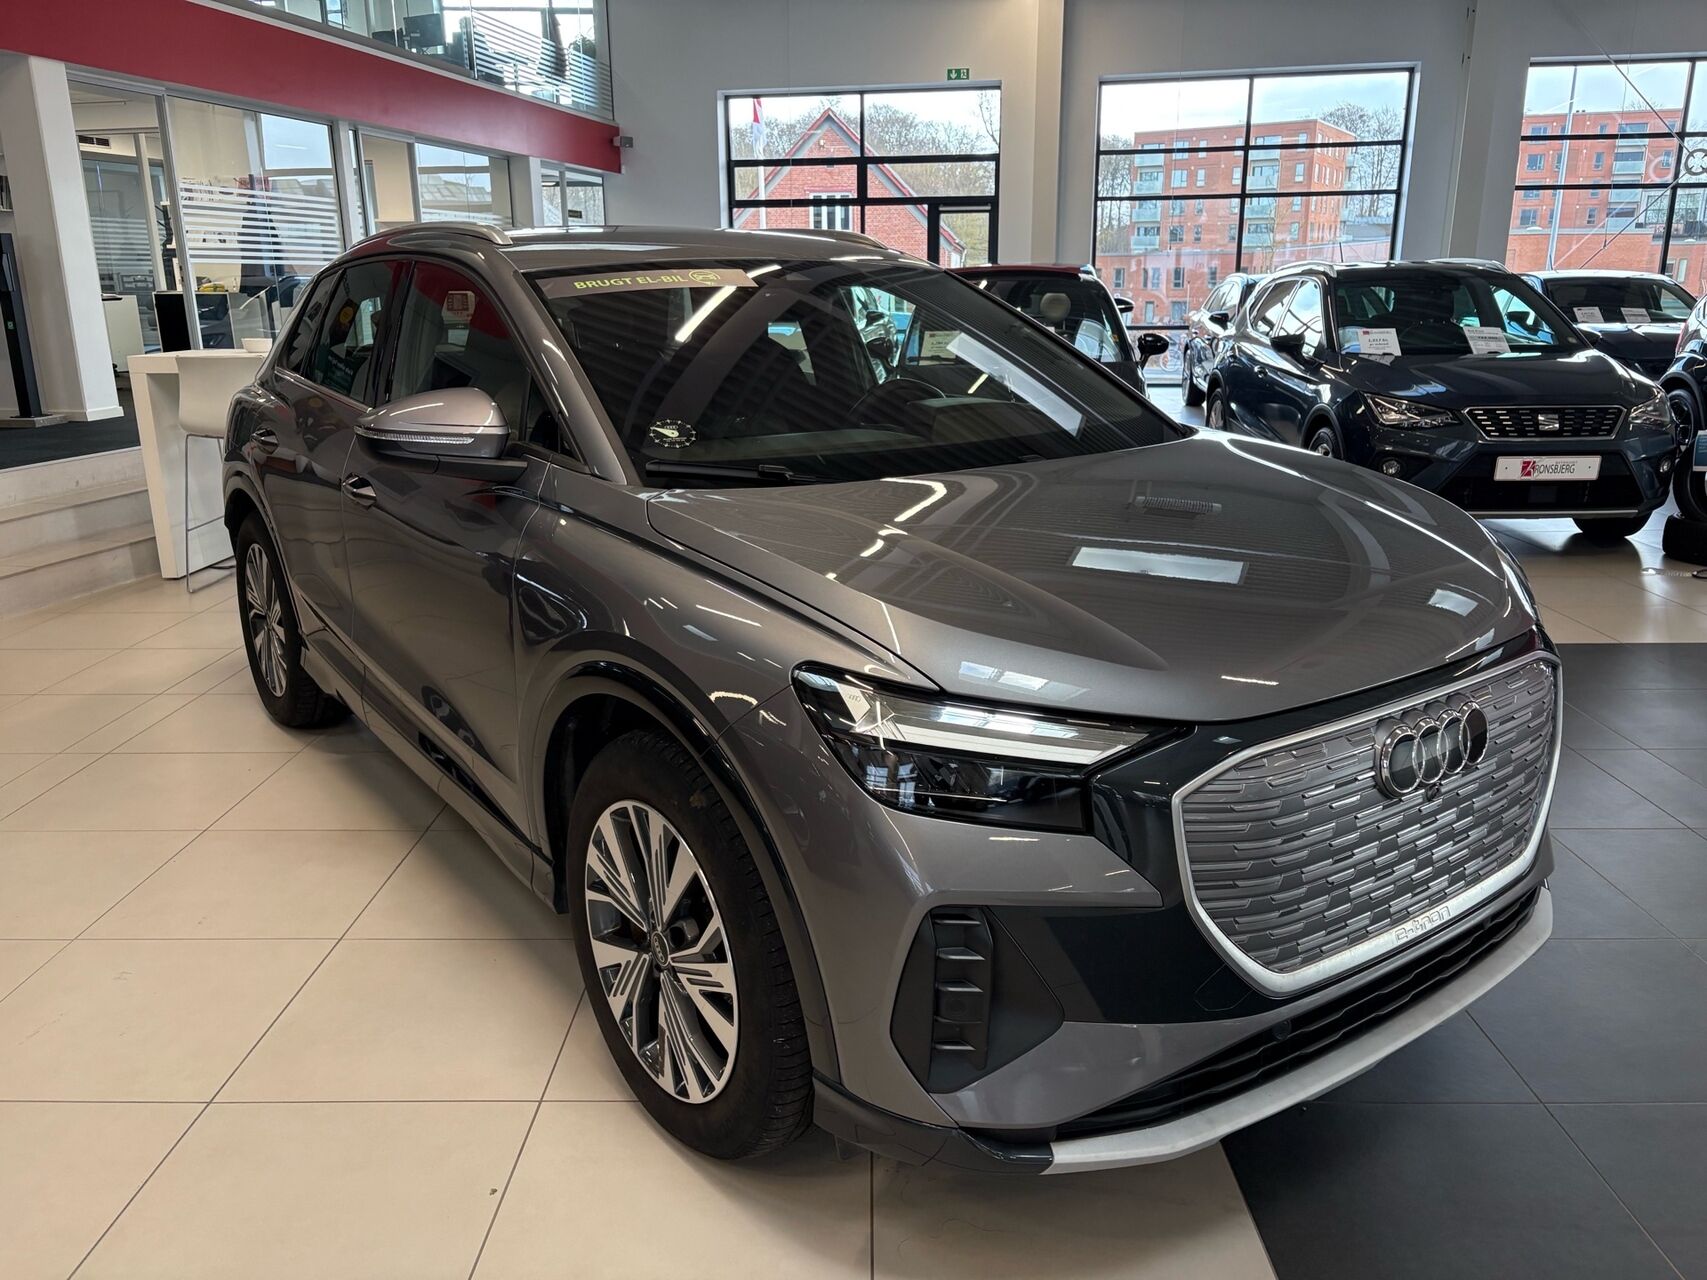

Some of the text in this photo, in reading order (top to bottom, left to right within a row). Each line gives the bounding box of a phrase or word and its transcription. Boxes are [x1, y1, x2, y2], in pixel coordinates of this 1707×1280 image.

[573, 274, 688, 290] BRUGT EL-BIL
[1394, 905, 1451, 943] e-tron
